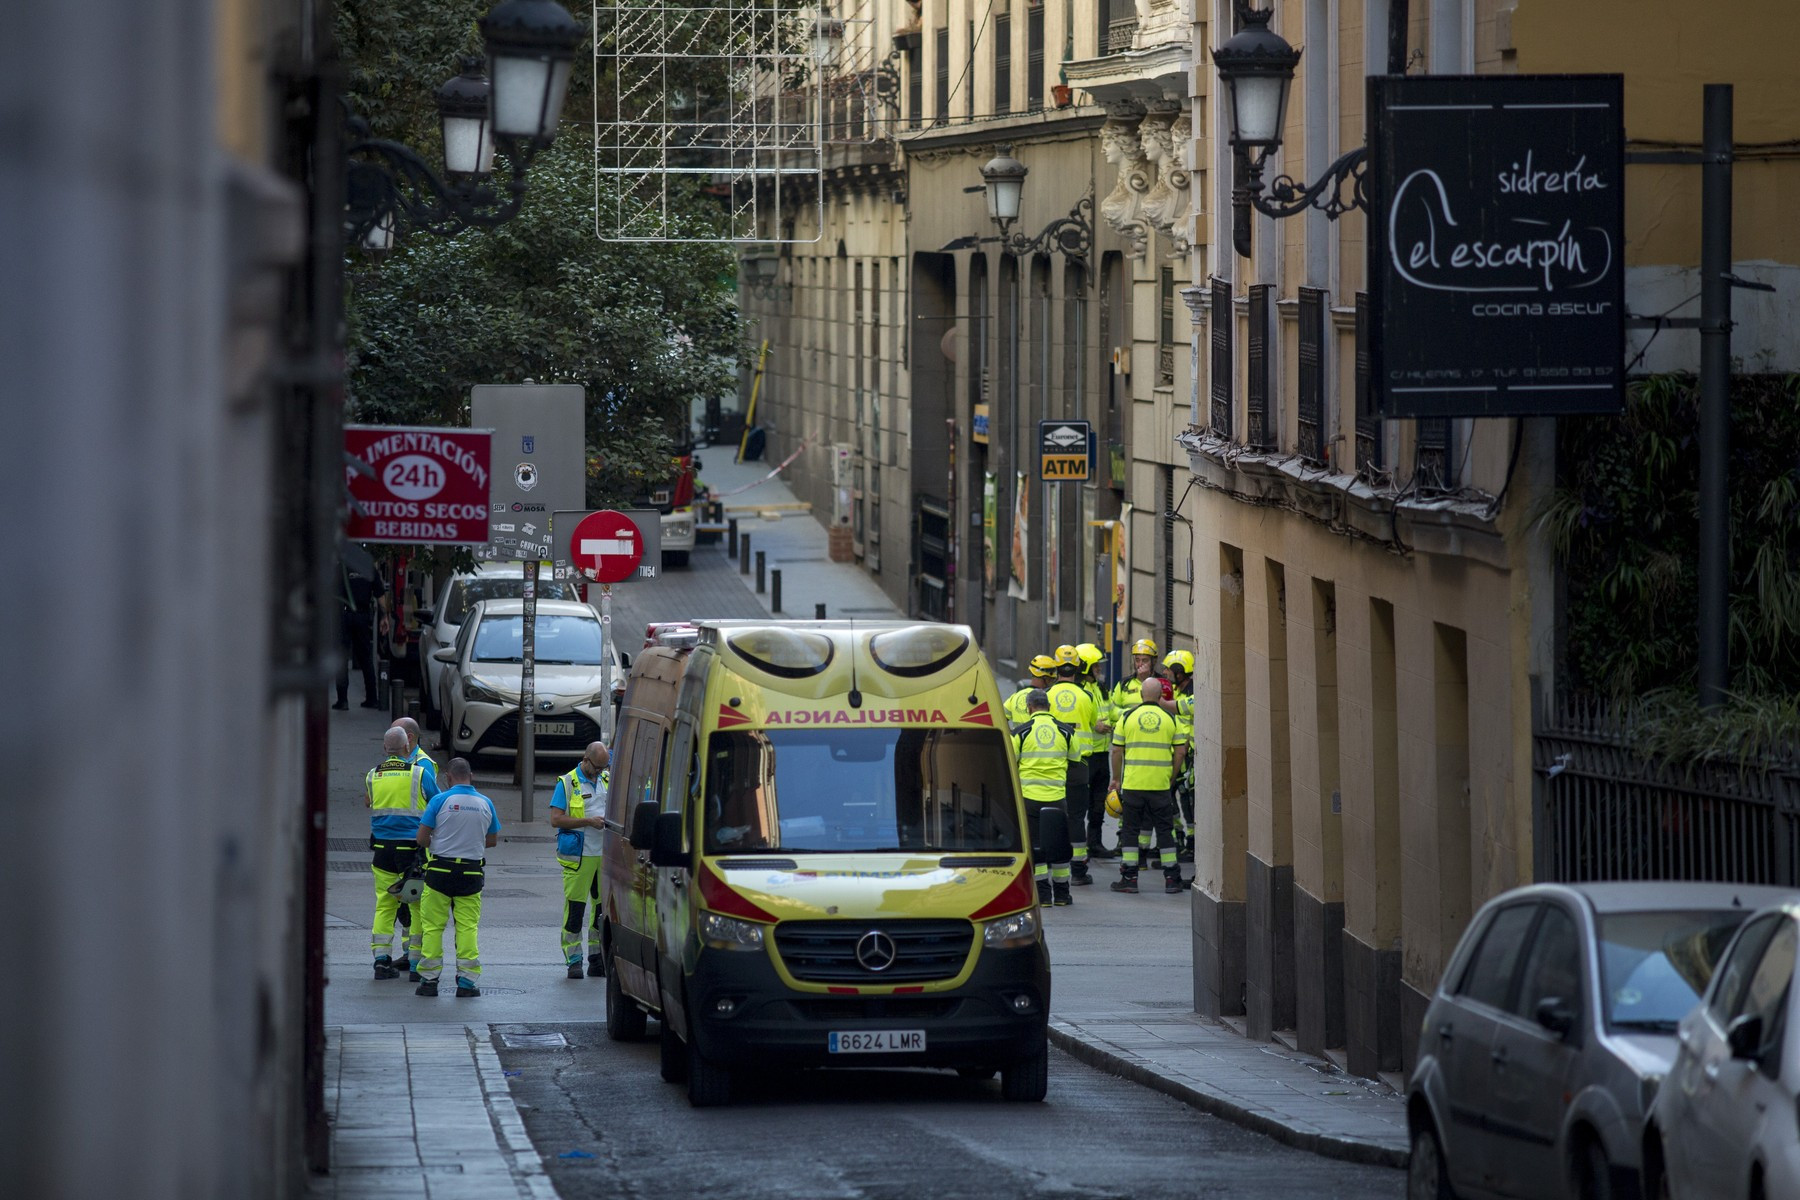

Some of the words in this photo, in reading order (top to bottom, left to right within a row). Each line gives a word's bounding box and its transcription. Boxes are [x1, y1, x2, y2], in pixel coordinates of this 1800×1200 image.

[1498, 149, 1608, 195] sidrería
[1451, 218, 1588, 291] escarpín
[1472, 303, 1543, 317] cocina
[1548, 301, 1611, 315] astur
[1471, 369, 1484, 378] 17
[346, 433, 488, 491] AIMENTACIÓN
[1044, 460, 1086, 475] ATM
[390, 464, 439, 487] 24h
[347, 501, 420, 518] RUTOS
[424, 503, 488, 520] SECOS
[375, 521, 458, 539] BEBIDAS
[552, 723, 572, 734] JZL
[841, 1034, 883, 1050] 6624
[889, 1033, 922, 1049] LMR
